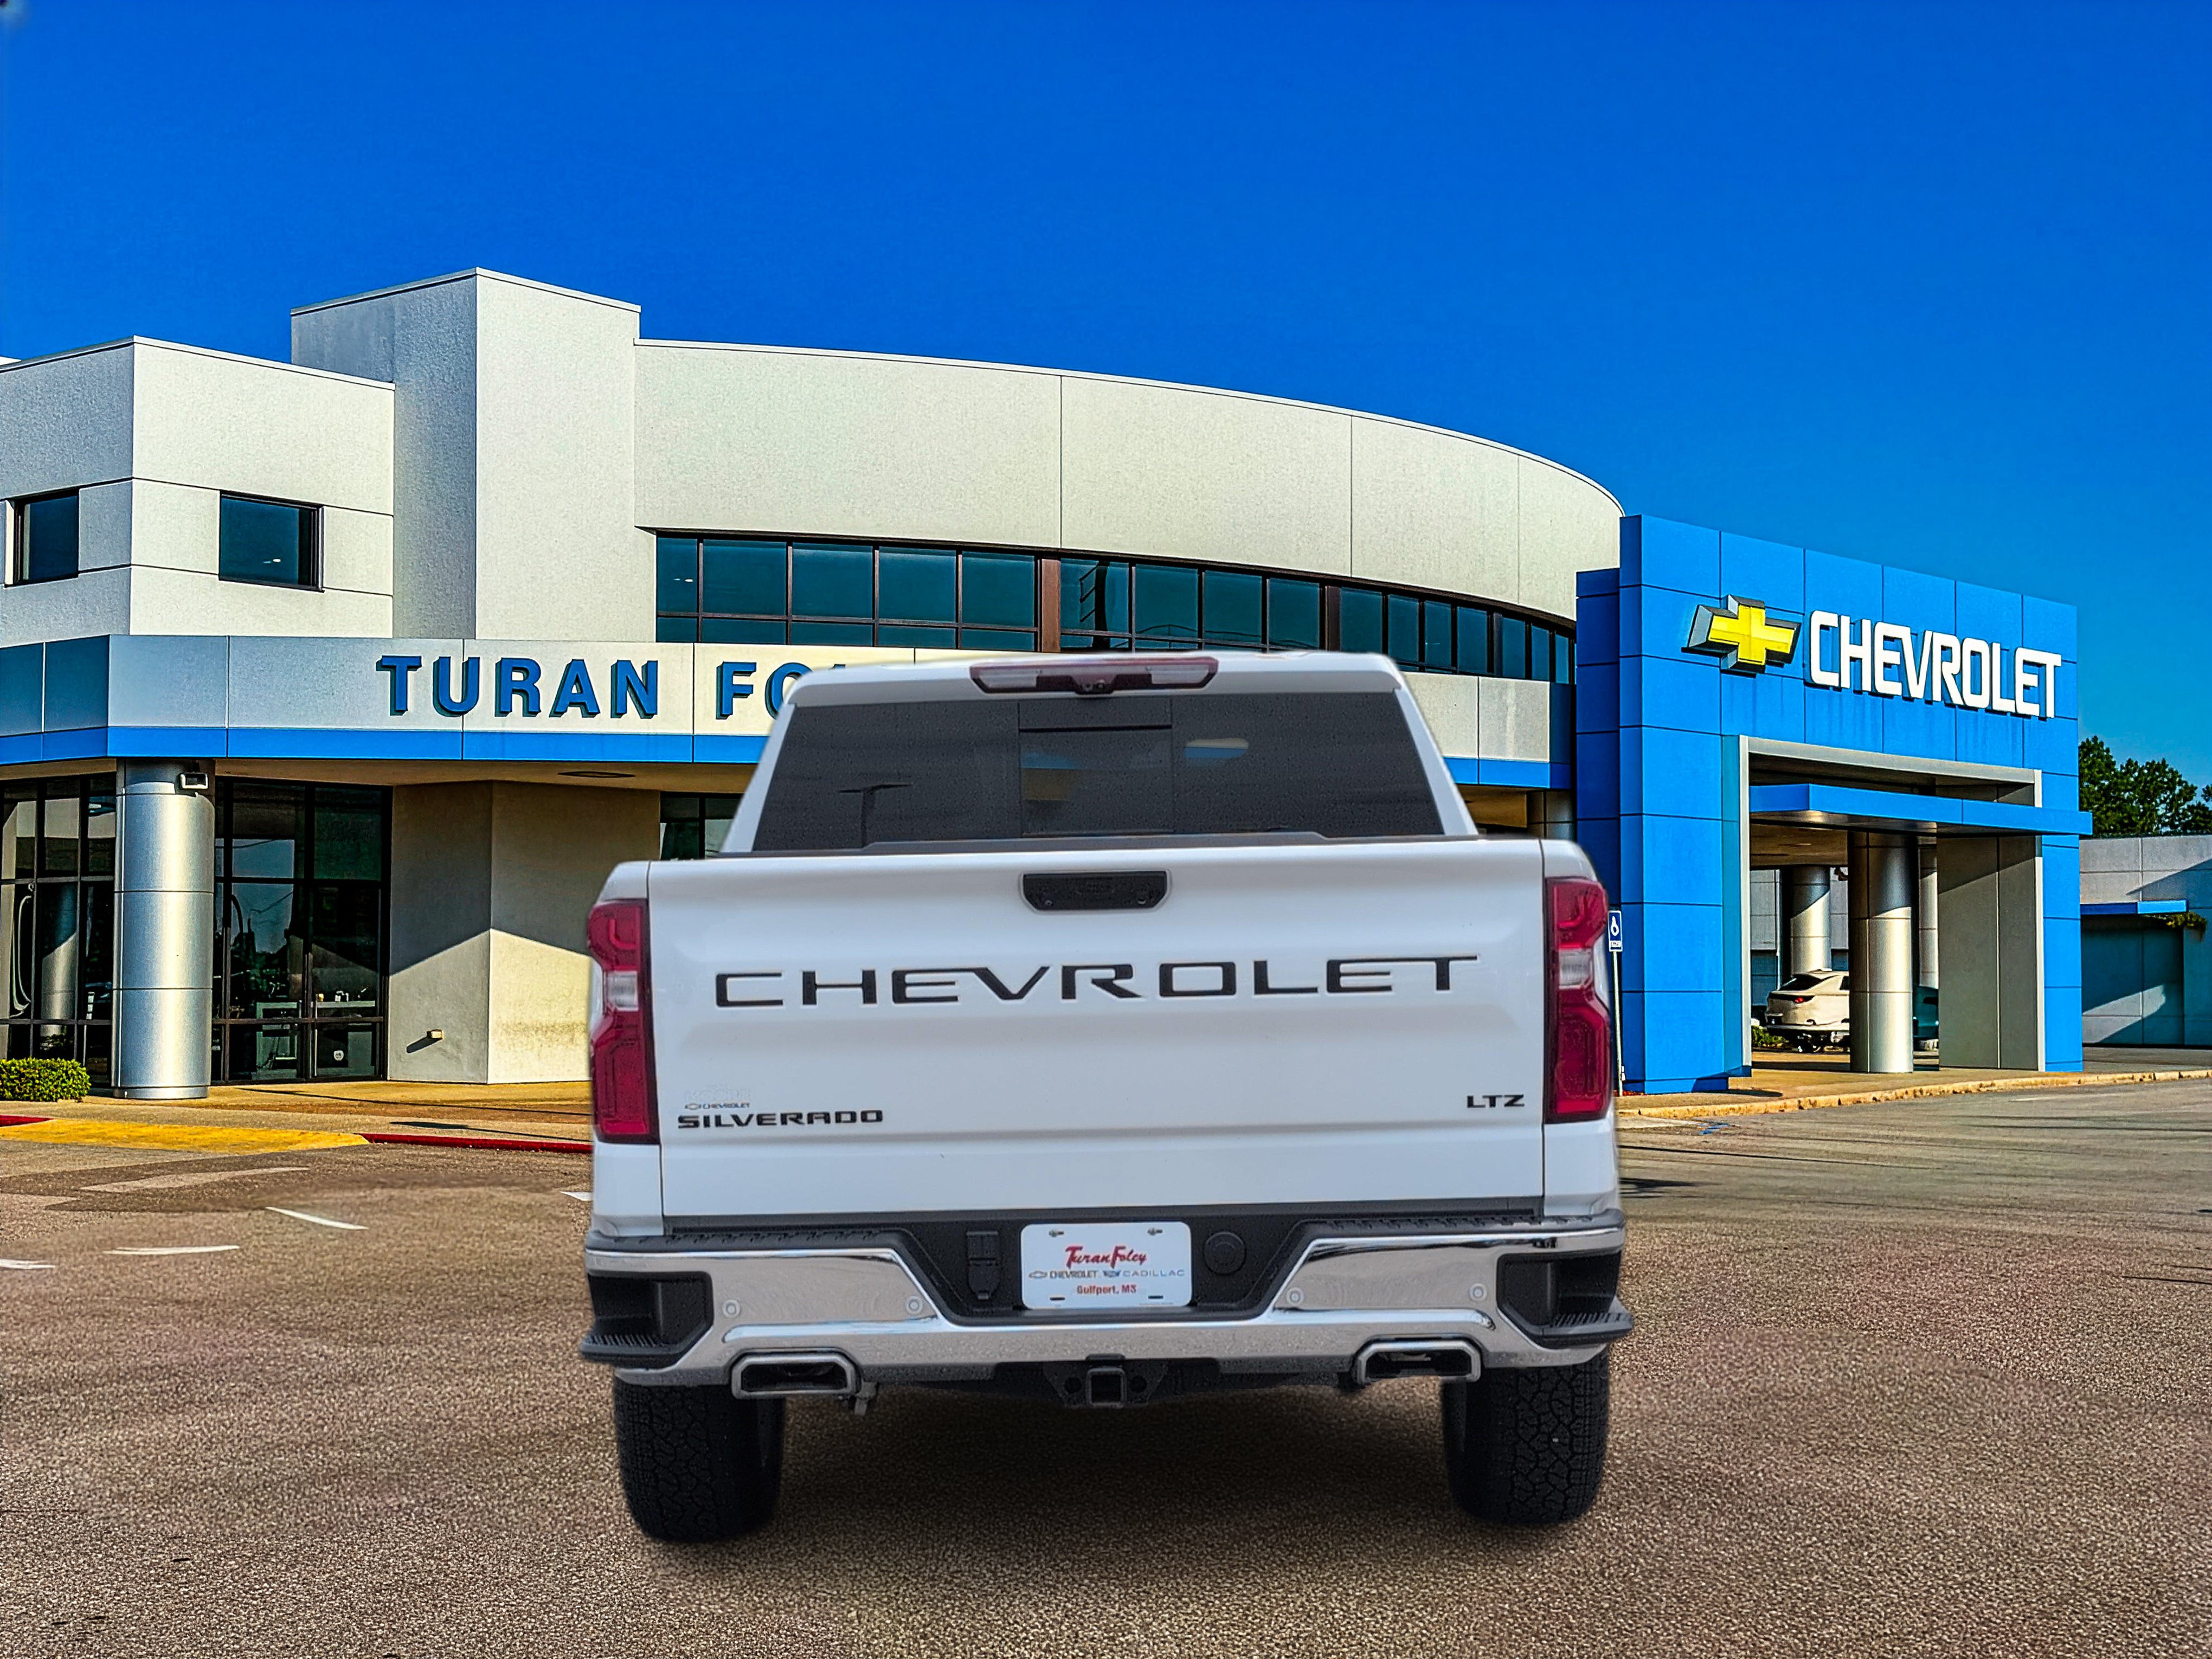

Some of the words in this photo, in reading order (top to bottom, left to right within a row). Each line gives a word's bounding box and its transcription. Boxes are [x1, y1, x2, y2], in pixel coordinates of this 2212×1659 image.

[1809, 610, 2062, 718] CHEVROLET
[376, 655, 658, 719] TURAN
[716, 661, 847, 720] FO
[715, 955, 1478, 1007] CHEVROLET
[1467, 1094, 1525, 1108] LTZ
[678, 1110, 883, 1128] SILVERADO
[1121, 1284, 1137, 1294] MS
